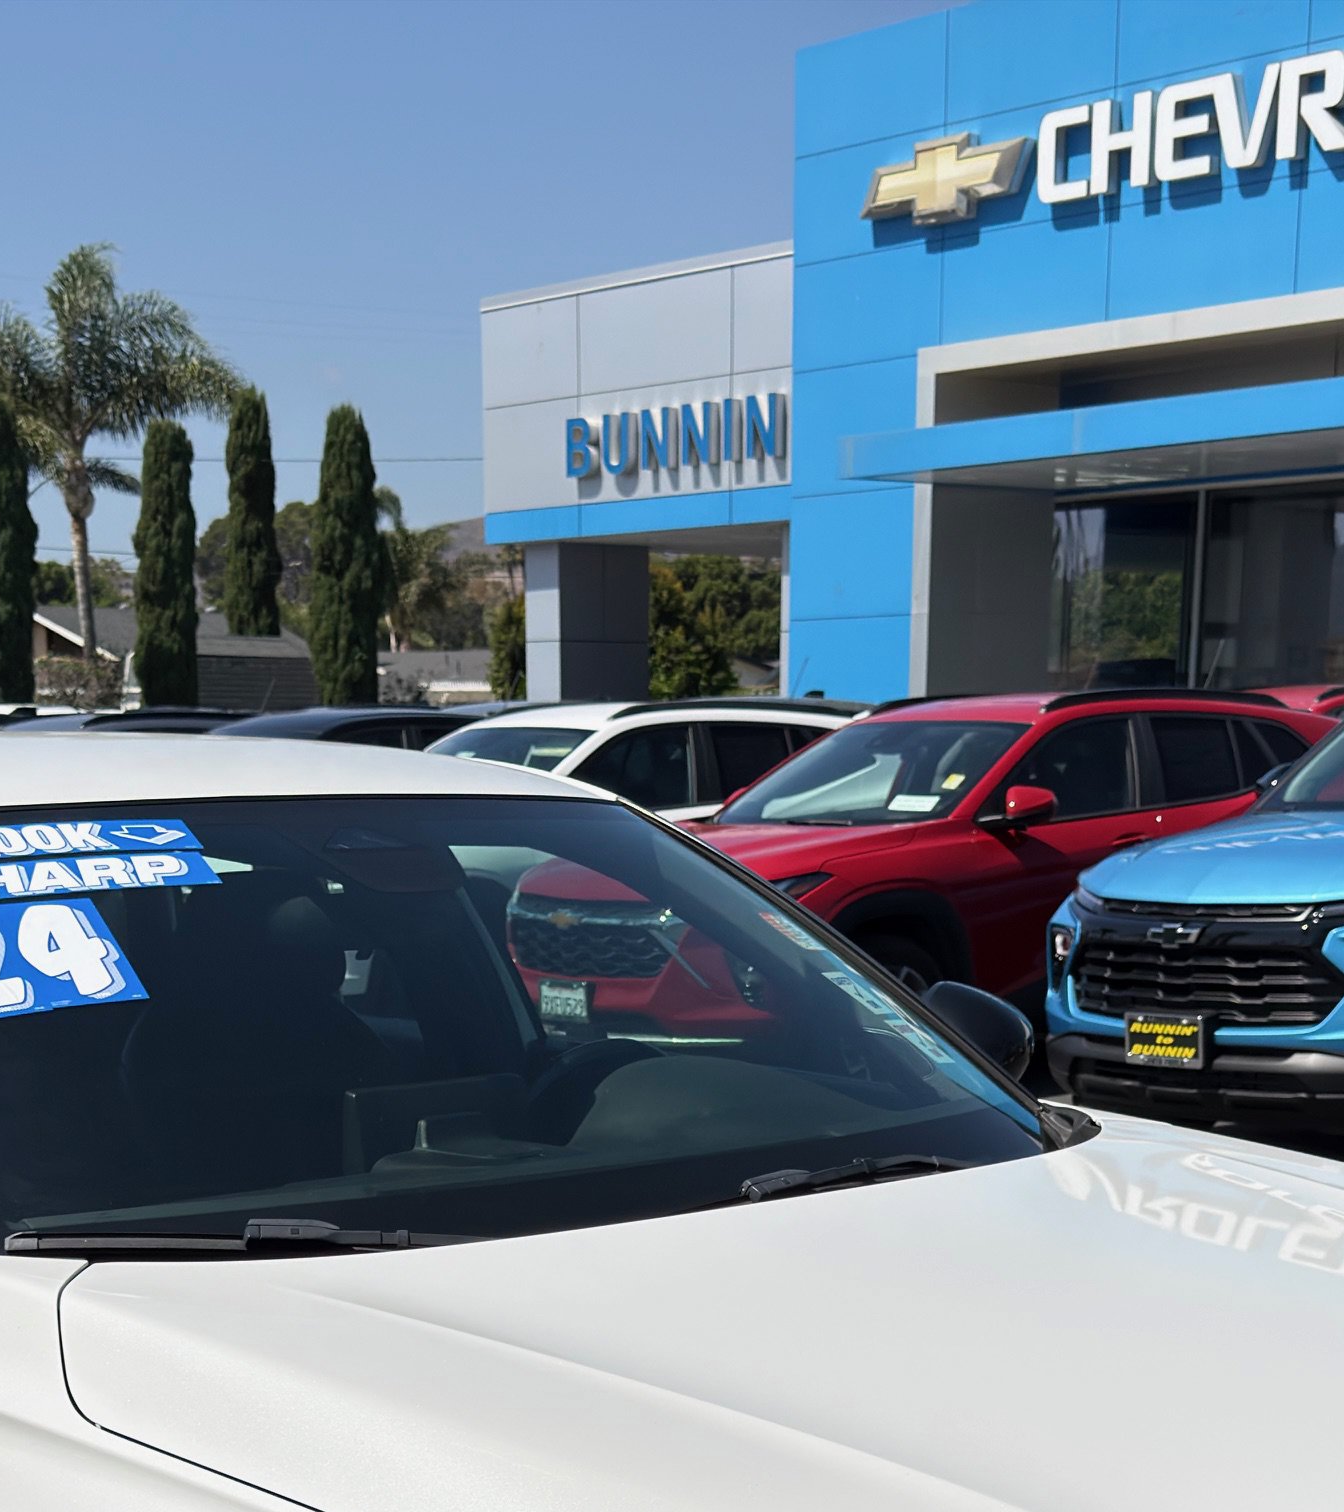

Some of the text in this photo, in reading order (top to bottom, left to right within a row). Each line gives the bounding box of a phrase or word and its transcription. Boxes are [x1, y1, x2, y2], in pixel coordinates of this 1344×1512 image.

[566, 392, 787, 478] BUNNIN
[1156, 1035, 1174, 1044] to
[1131, 1044, 1196, 1059] BUNNIN
